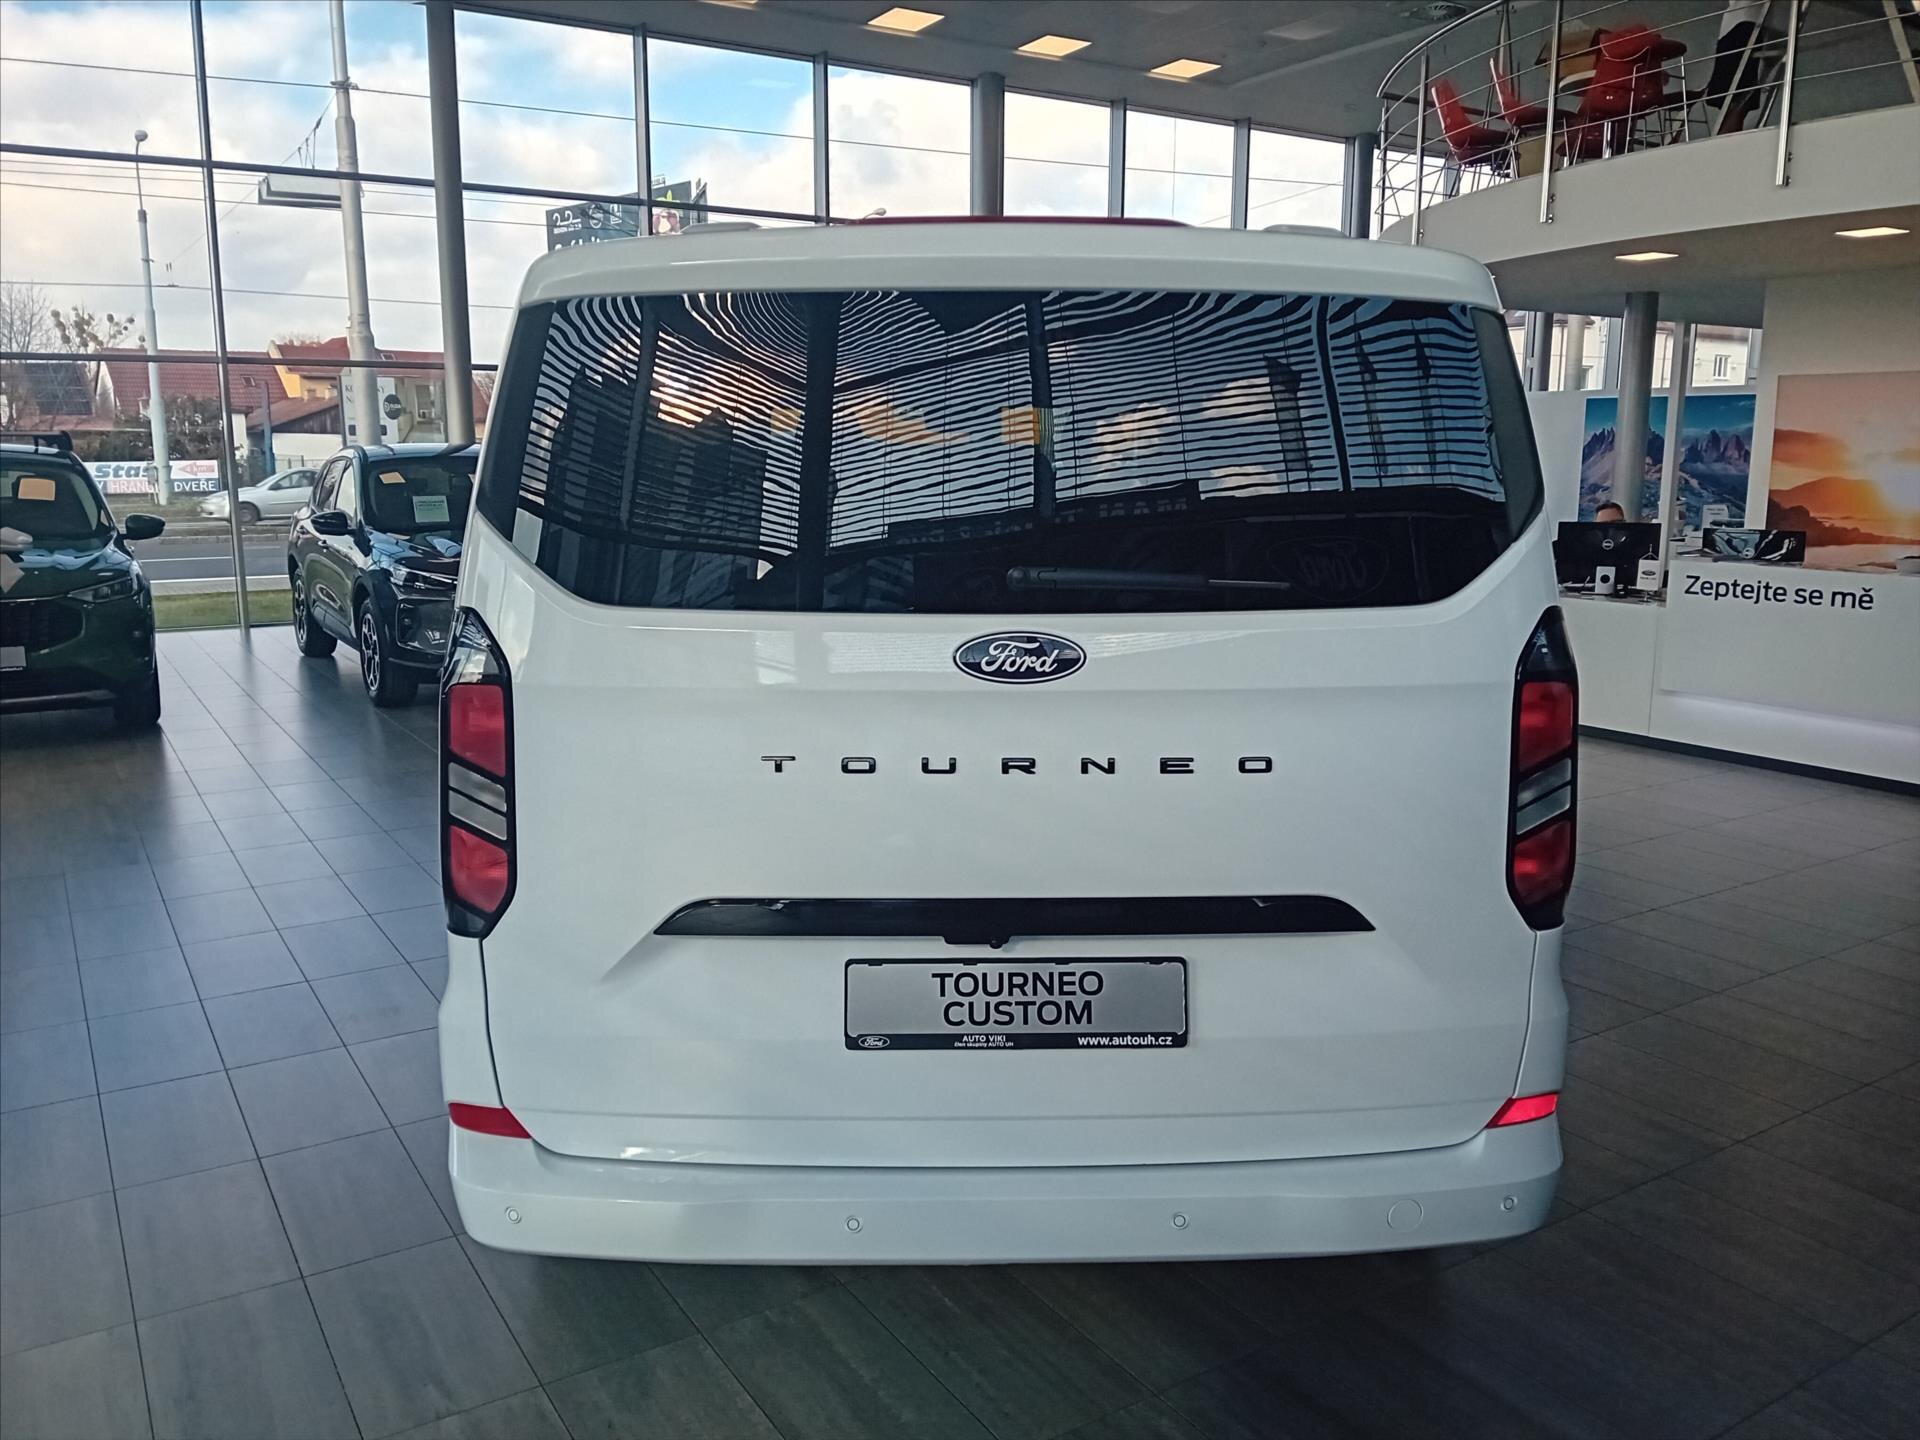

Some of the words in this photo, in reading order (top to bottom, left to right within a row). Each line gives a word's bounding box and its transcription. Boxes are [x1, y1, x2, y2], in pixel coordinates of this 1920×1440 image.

[174, 478, 217, 492] DVEŘE
[1684, 575, 1787, 604] Zeptejte
[1793, 587, 1823, 606] se
[1830, 587, 1875, 611] mě
[980, 639, 1058, 673] Ford
[761, 755, 1274, 776] TOURNEO
[931, 970, 1104, 998] TOURNEO
[942, 999, 1093, 1026] CUSTOM
[962, 1034, 986, 1042] AUTO
[988, 1034, 1006, 1042] VIKI
[1077, 1034, 1173, 1046] www.autouh.cz
